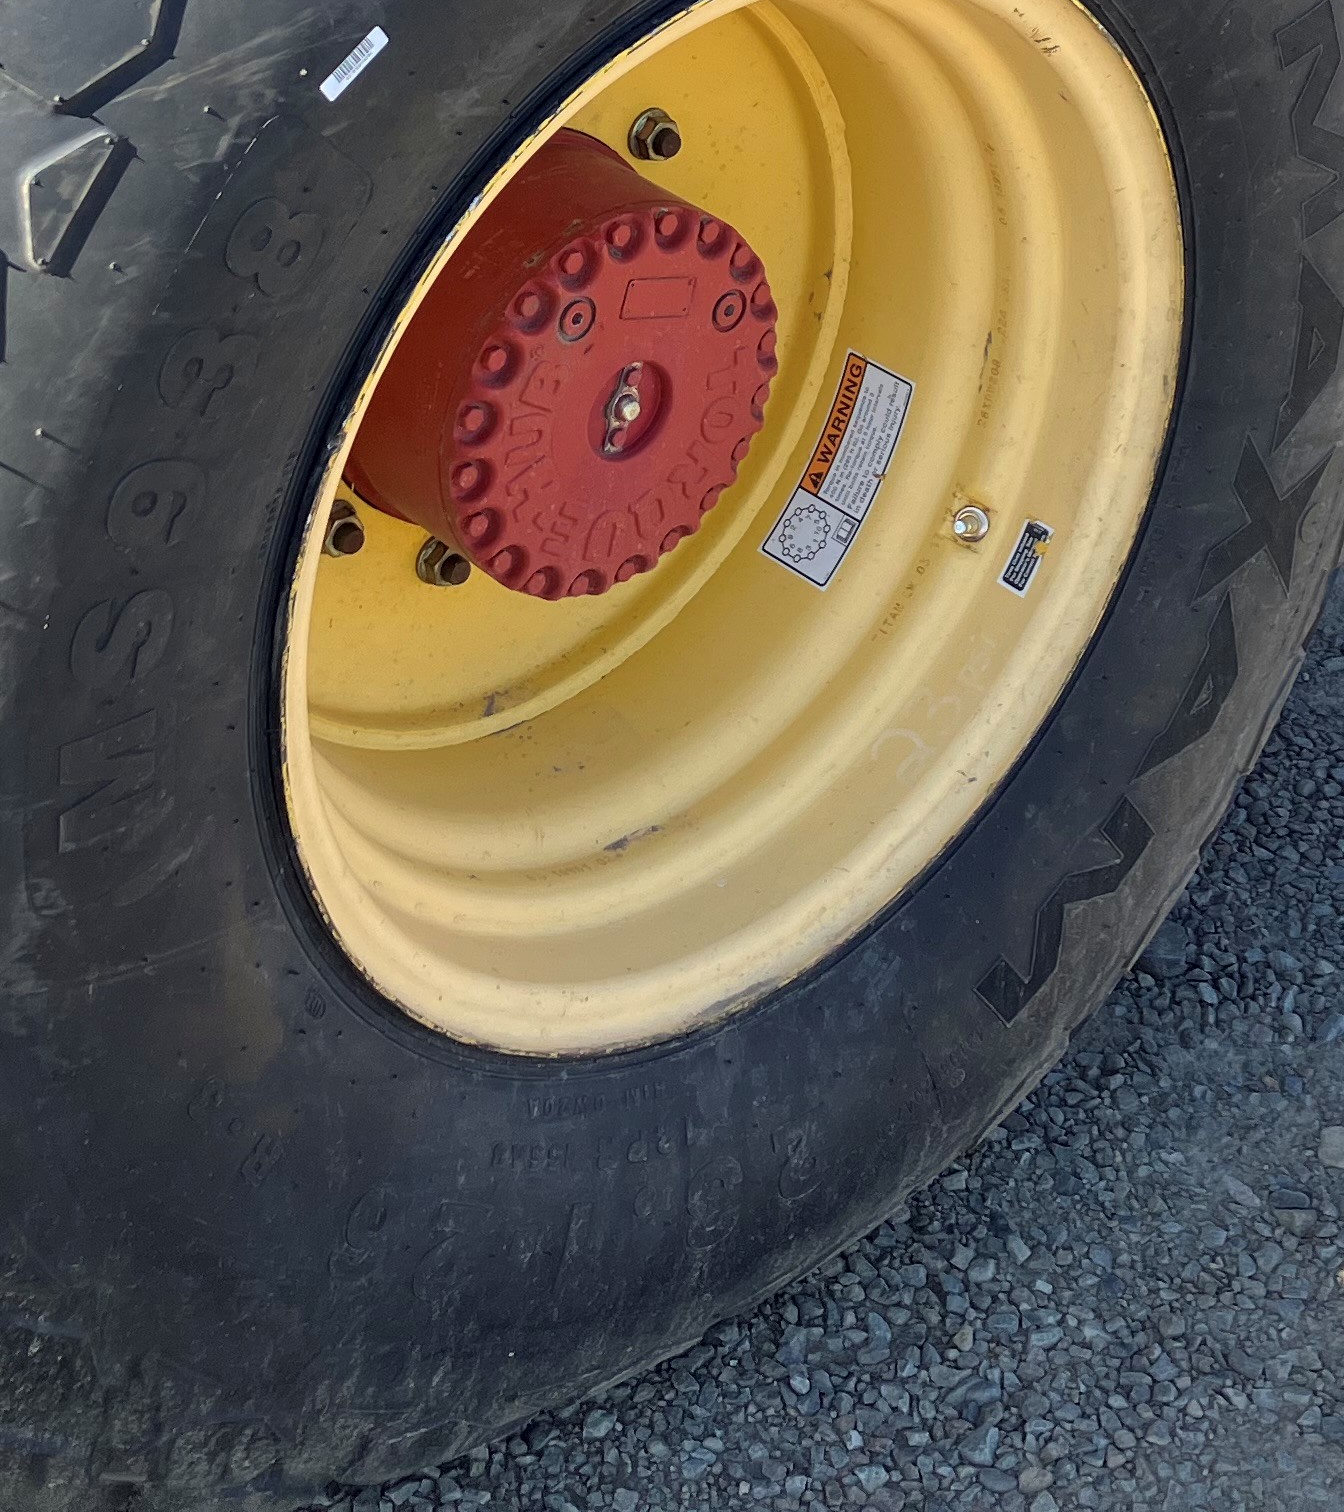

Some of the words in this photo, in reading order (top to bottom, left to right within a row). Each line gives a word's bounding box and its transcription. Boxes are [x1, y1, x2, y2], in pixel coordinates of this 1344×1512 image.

[886, 380, 901, 406] result
[816, 362, 864, 465] WARNING
[879, 407, 892, 433] could
[865, 434, 885, 468] comply
[852, 502, 862, 513] in
[858, 477, 873, 503] death
[872, 432, 895, 465] serious
[861, 468, 870, 479] to
[846, 479, 866, 510] Failure
[58, 196, 324, 856] MS938
